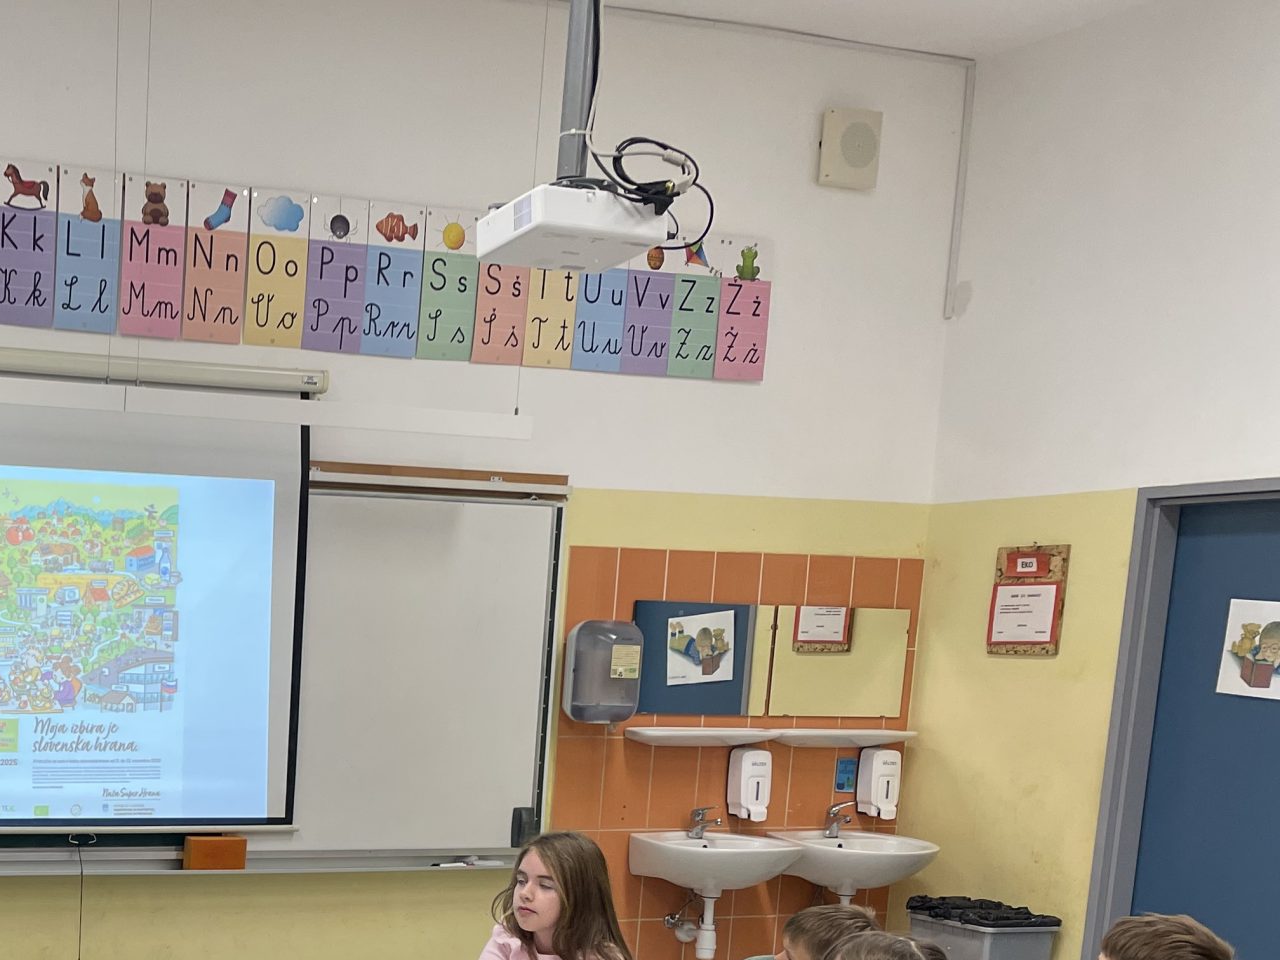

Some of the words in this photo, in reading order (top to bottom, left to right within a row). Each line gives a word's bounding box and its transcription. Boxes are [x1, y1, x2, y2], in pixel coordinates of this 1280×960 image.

[34, 716, 67, 740] Moja
[71, 720, 105, 733] izbira
[103, 721, 120, 739] je
[32, 736, 93, 753] slovenska
